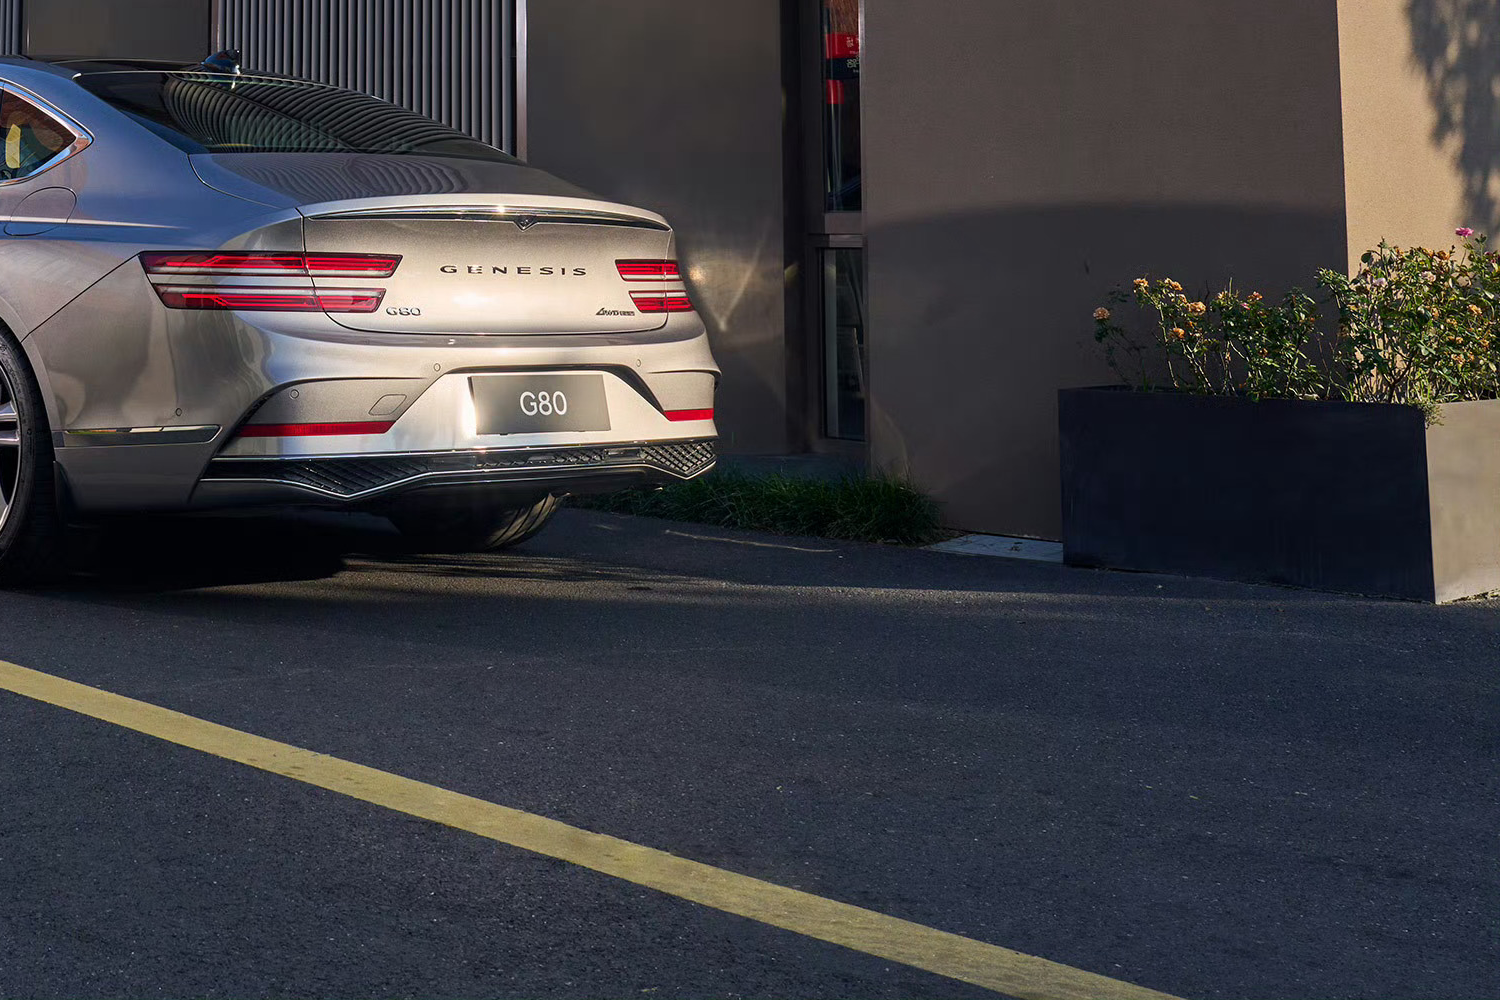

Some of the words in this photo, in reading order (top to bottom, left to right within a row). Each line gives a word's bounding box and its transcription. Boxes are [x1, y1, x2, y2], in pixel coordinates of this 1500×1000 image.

[440, 265, 587, 276] GENESIS
[386, 306, 422, 316] G80
[520, 391, 567, 416] G80
